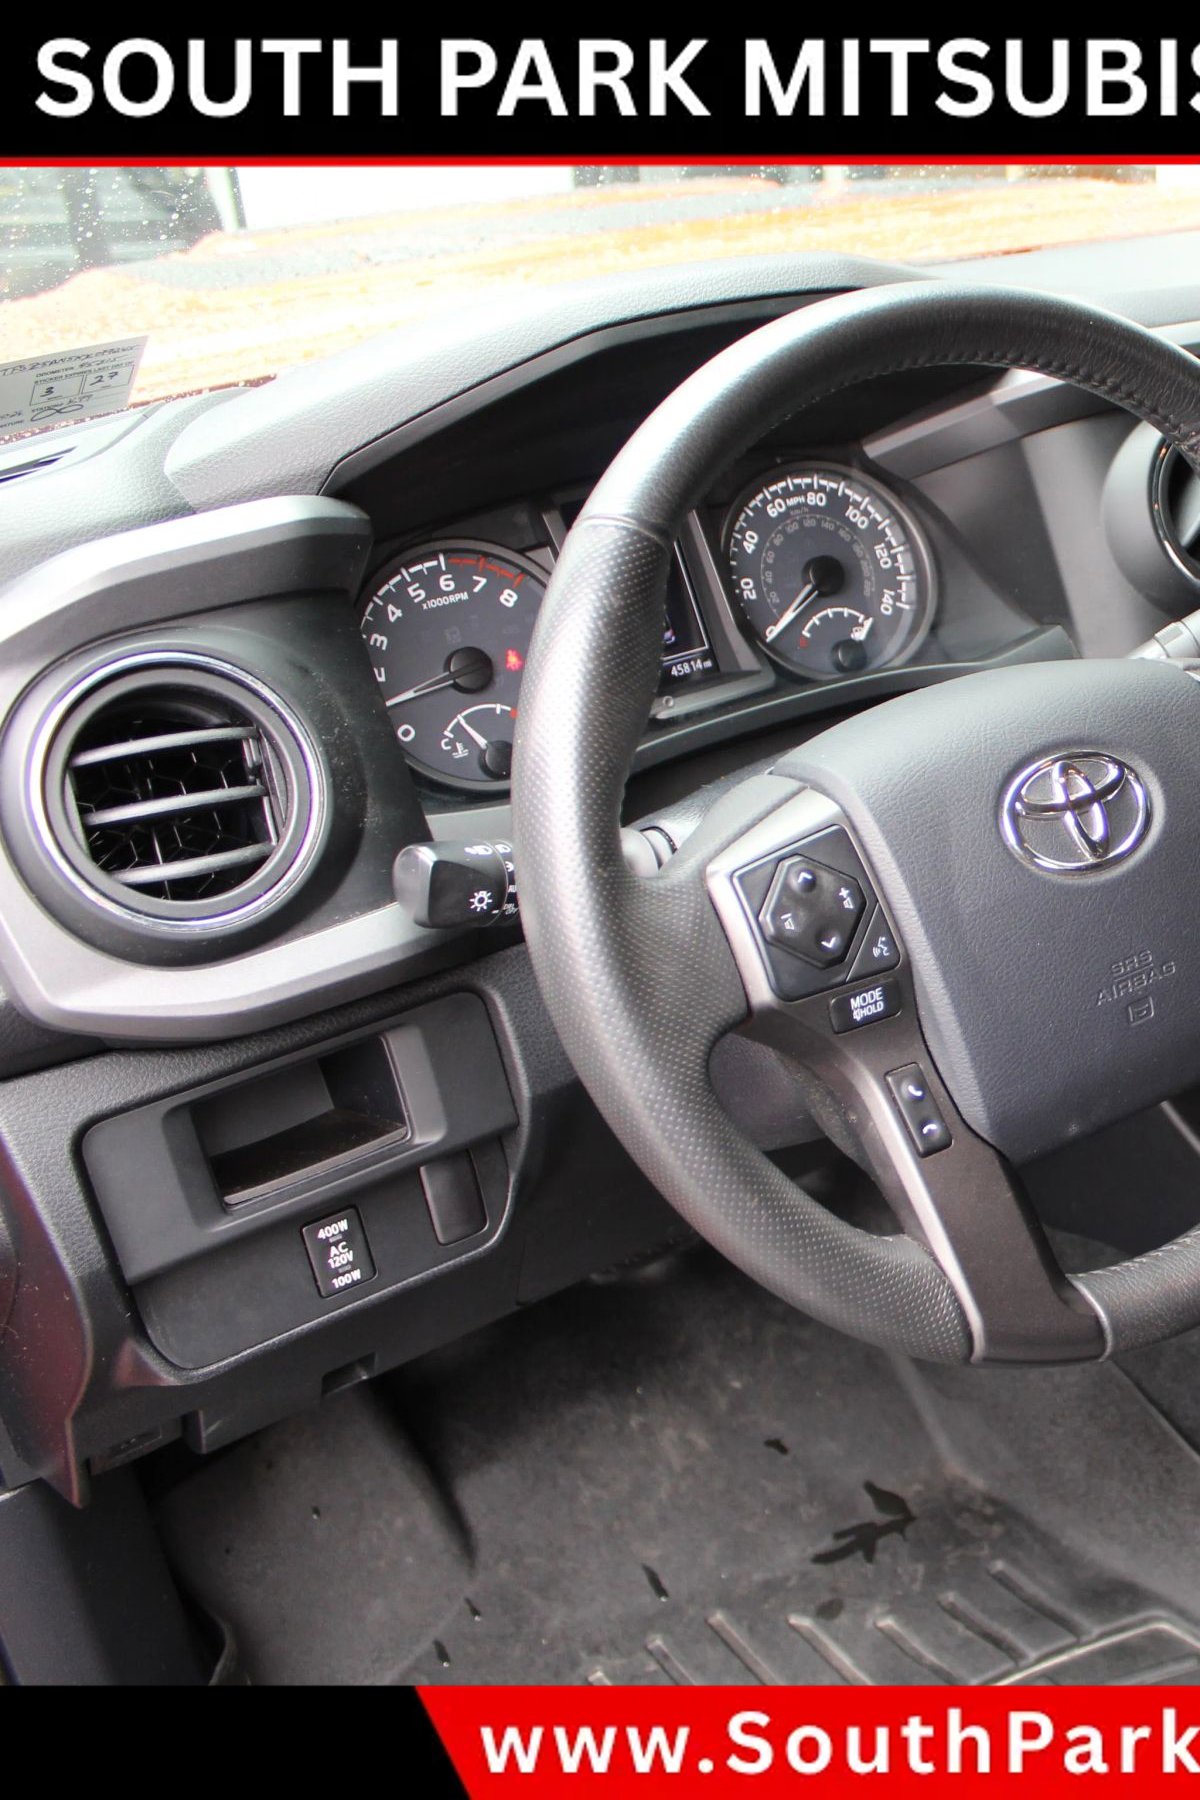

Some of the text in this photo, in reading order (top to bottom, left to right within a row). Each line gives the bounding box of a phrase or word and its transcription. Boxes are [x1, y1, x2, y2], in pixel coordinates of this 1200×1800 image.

[767, 498, 786, 518] 60
[785, 495, 805, 507] MPH
[806, 491, 827, 507] 80
[845, 505, 869, 530] 100
[742, 530, 759, 554] 40
[873, 543, 892, 569] 120
[439, 574, 455, 591] 6
[472, 575, 487, 593] 7
[740, 577, 757, 600] 20
[407, 583, 426, 603] 5
[499, 588, 518, 608] 8
[880, 588, 895, 616] 140
[387, 604, 403, 622] 4
[370, 633, 387, 650] 3
[671, 658, 703, 677] 45814
[397, 724, 415, 742] 0
[441, 737, 451, 750] C
[1111, 949, 1153, 978] SRS
[1097, 960, 1176, 1008] AIRBAG
[850, 987, 883, 1010] MODE
[861, 1001, 884, 1018] HOLD
[317, 1218, 348, 1239] 400W
[328, 1250, 353, 1269] 120V
[329, 1241, 348, 1258] AC
[332, 1268, 361, 1289] 100W
